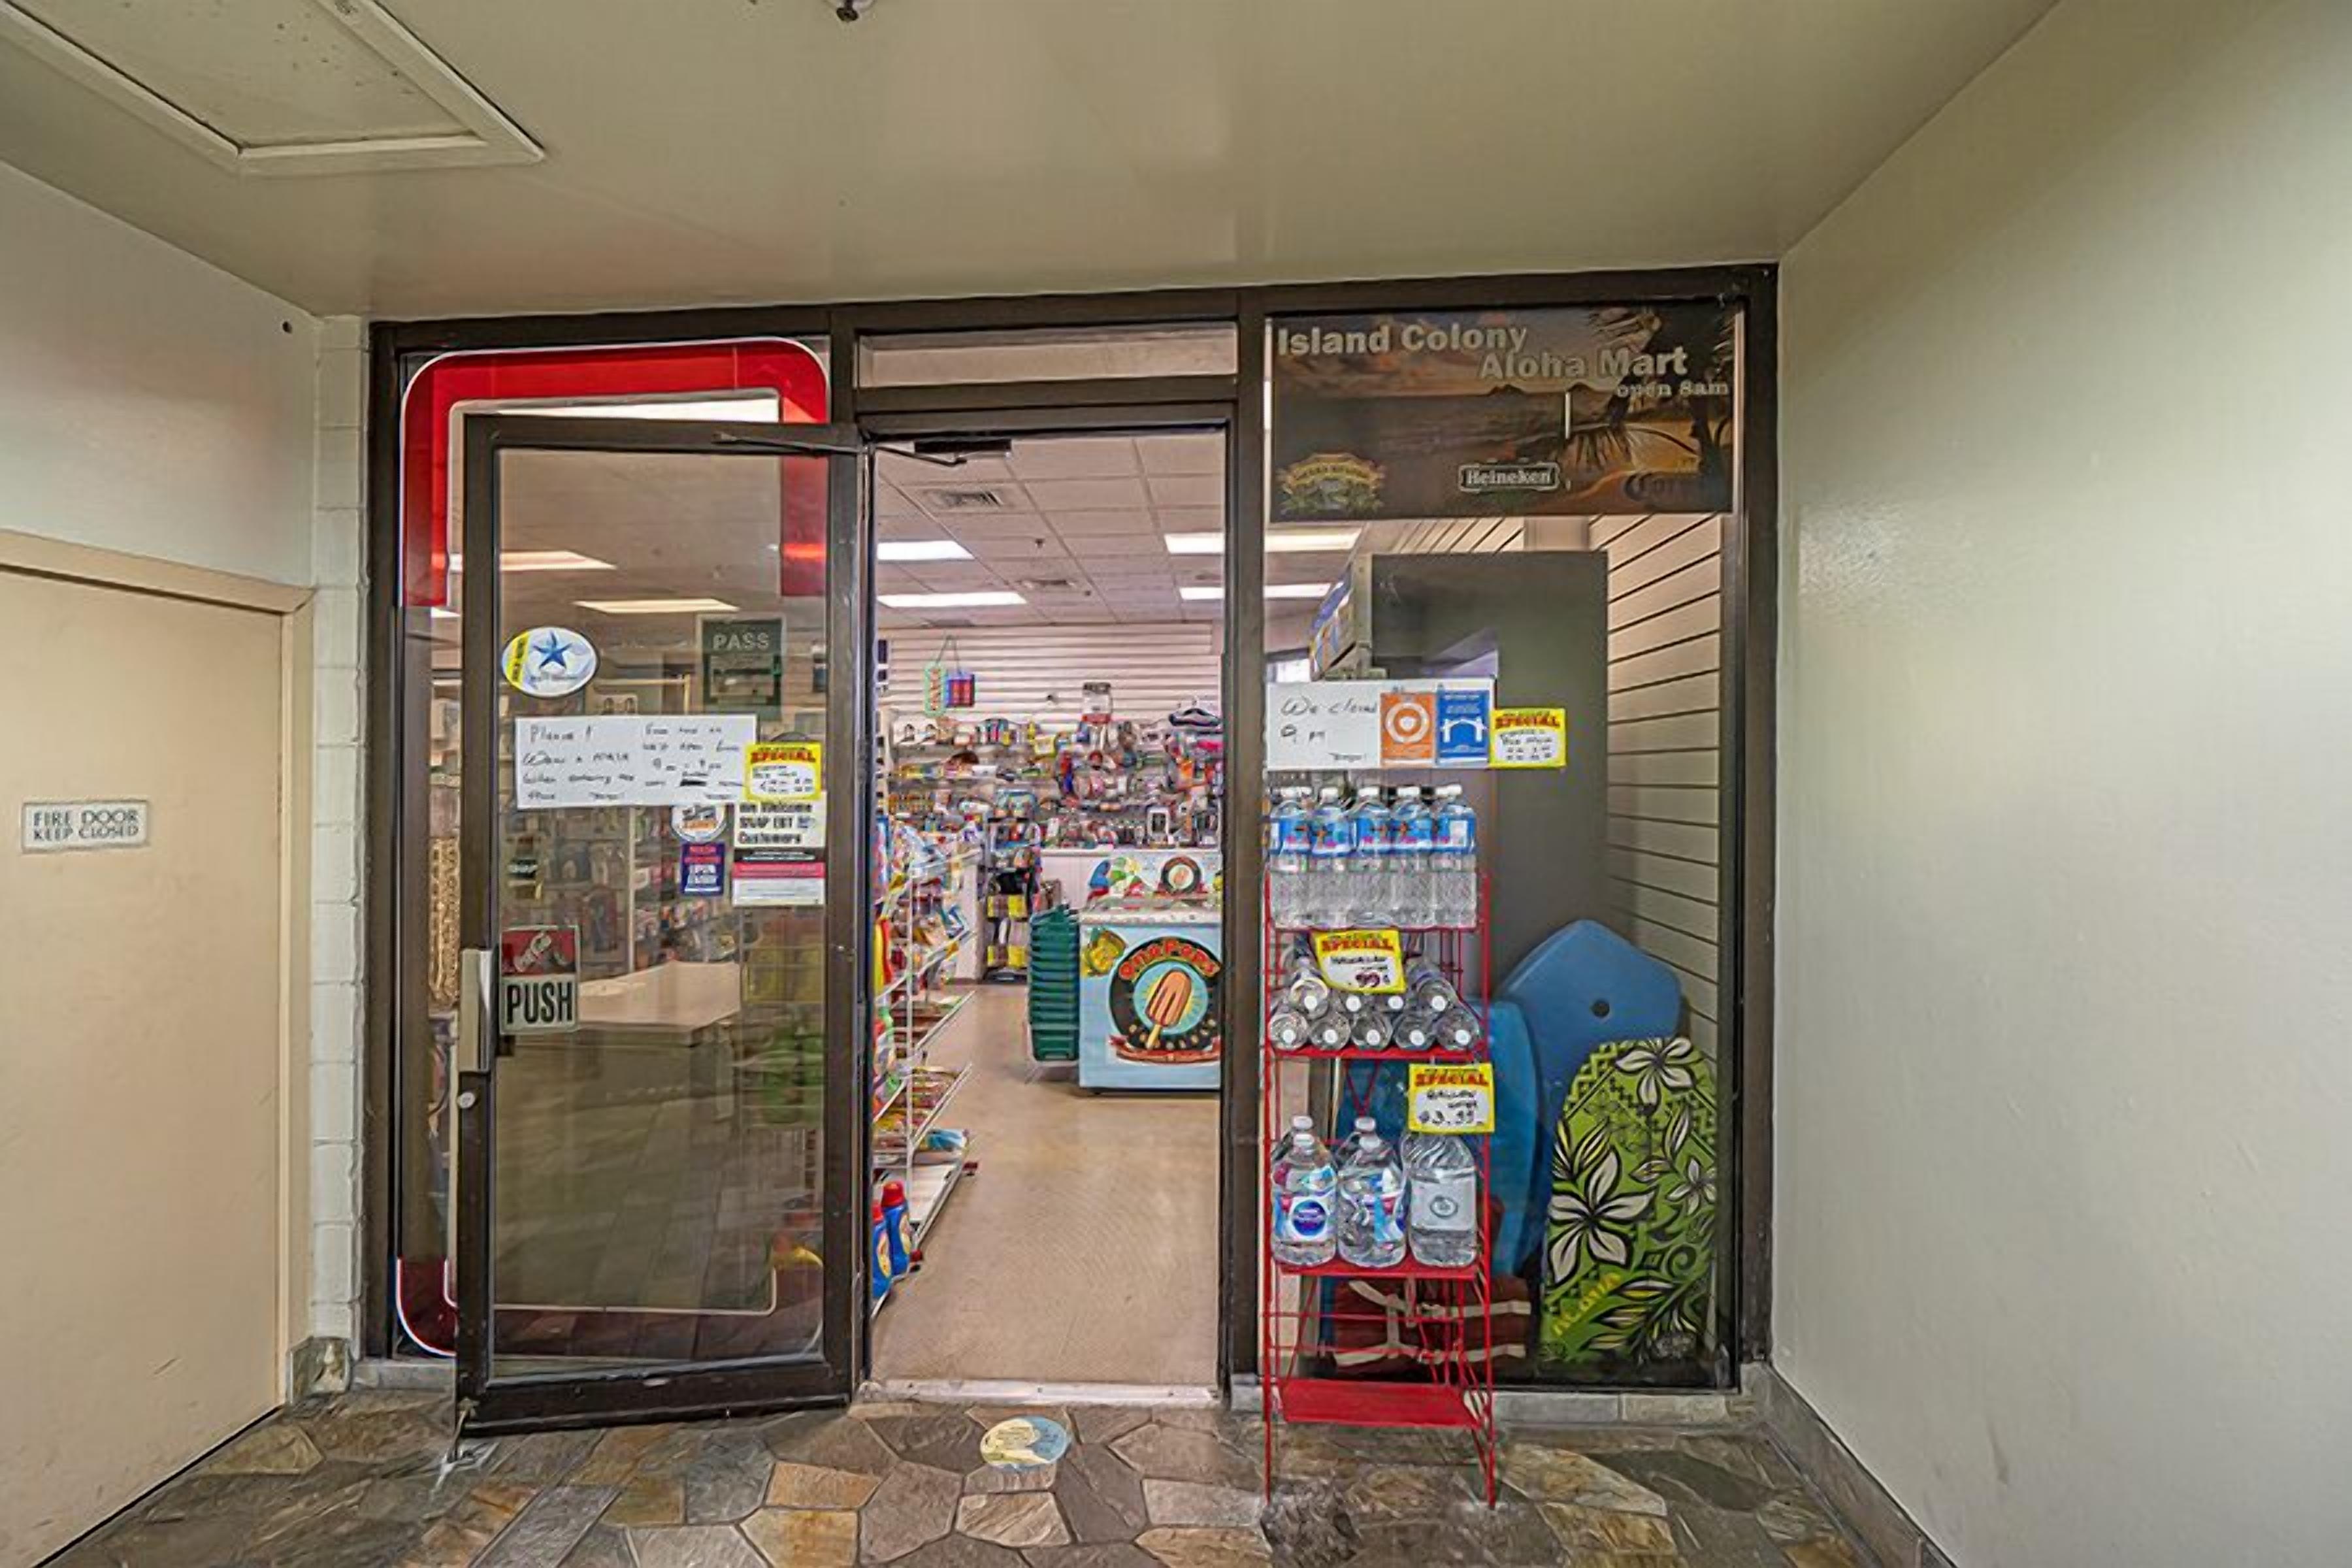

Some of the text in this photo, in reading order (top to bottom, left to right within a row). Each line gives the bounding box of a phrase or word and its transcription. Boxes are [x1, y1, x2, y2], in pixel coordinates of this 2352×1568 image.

[1277, 322, 1527, 355] Island Colony
[1480, 345, 1688, 378] Aloha Mart
[1466, 467, 1552, 485] Heineken
[712, 632, 770, 651] PASS
[1495, 715, 1561, 730] SPECIAL
[750, 751, 816, 764] SPECIAL
[34, 810, 138, 827] FIRE DOOR
[34, 825, 139, 841] KEEP CLOSED
[738, 832, 801, 845] Customers
[1322, 939, 1394, 952] SPECIAL
[506, 981, 573, 1024] PUSH
[1416, 1073, 1490, 1087] SPECIAL
